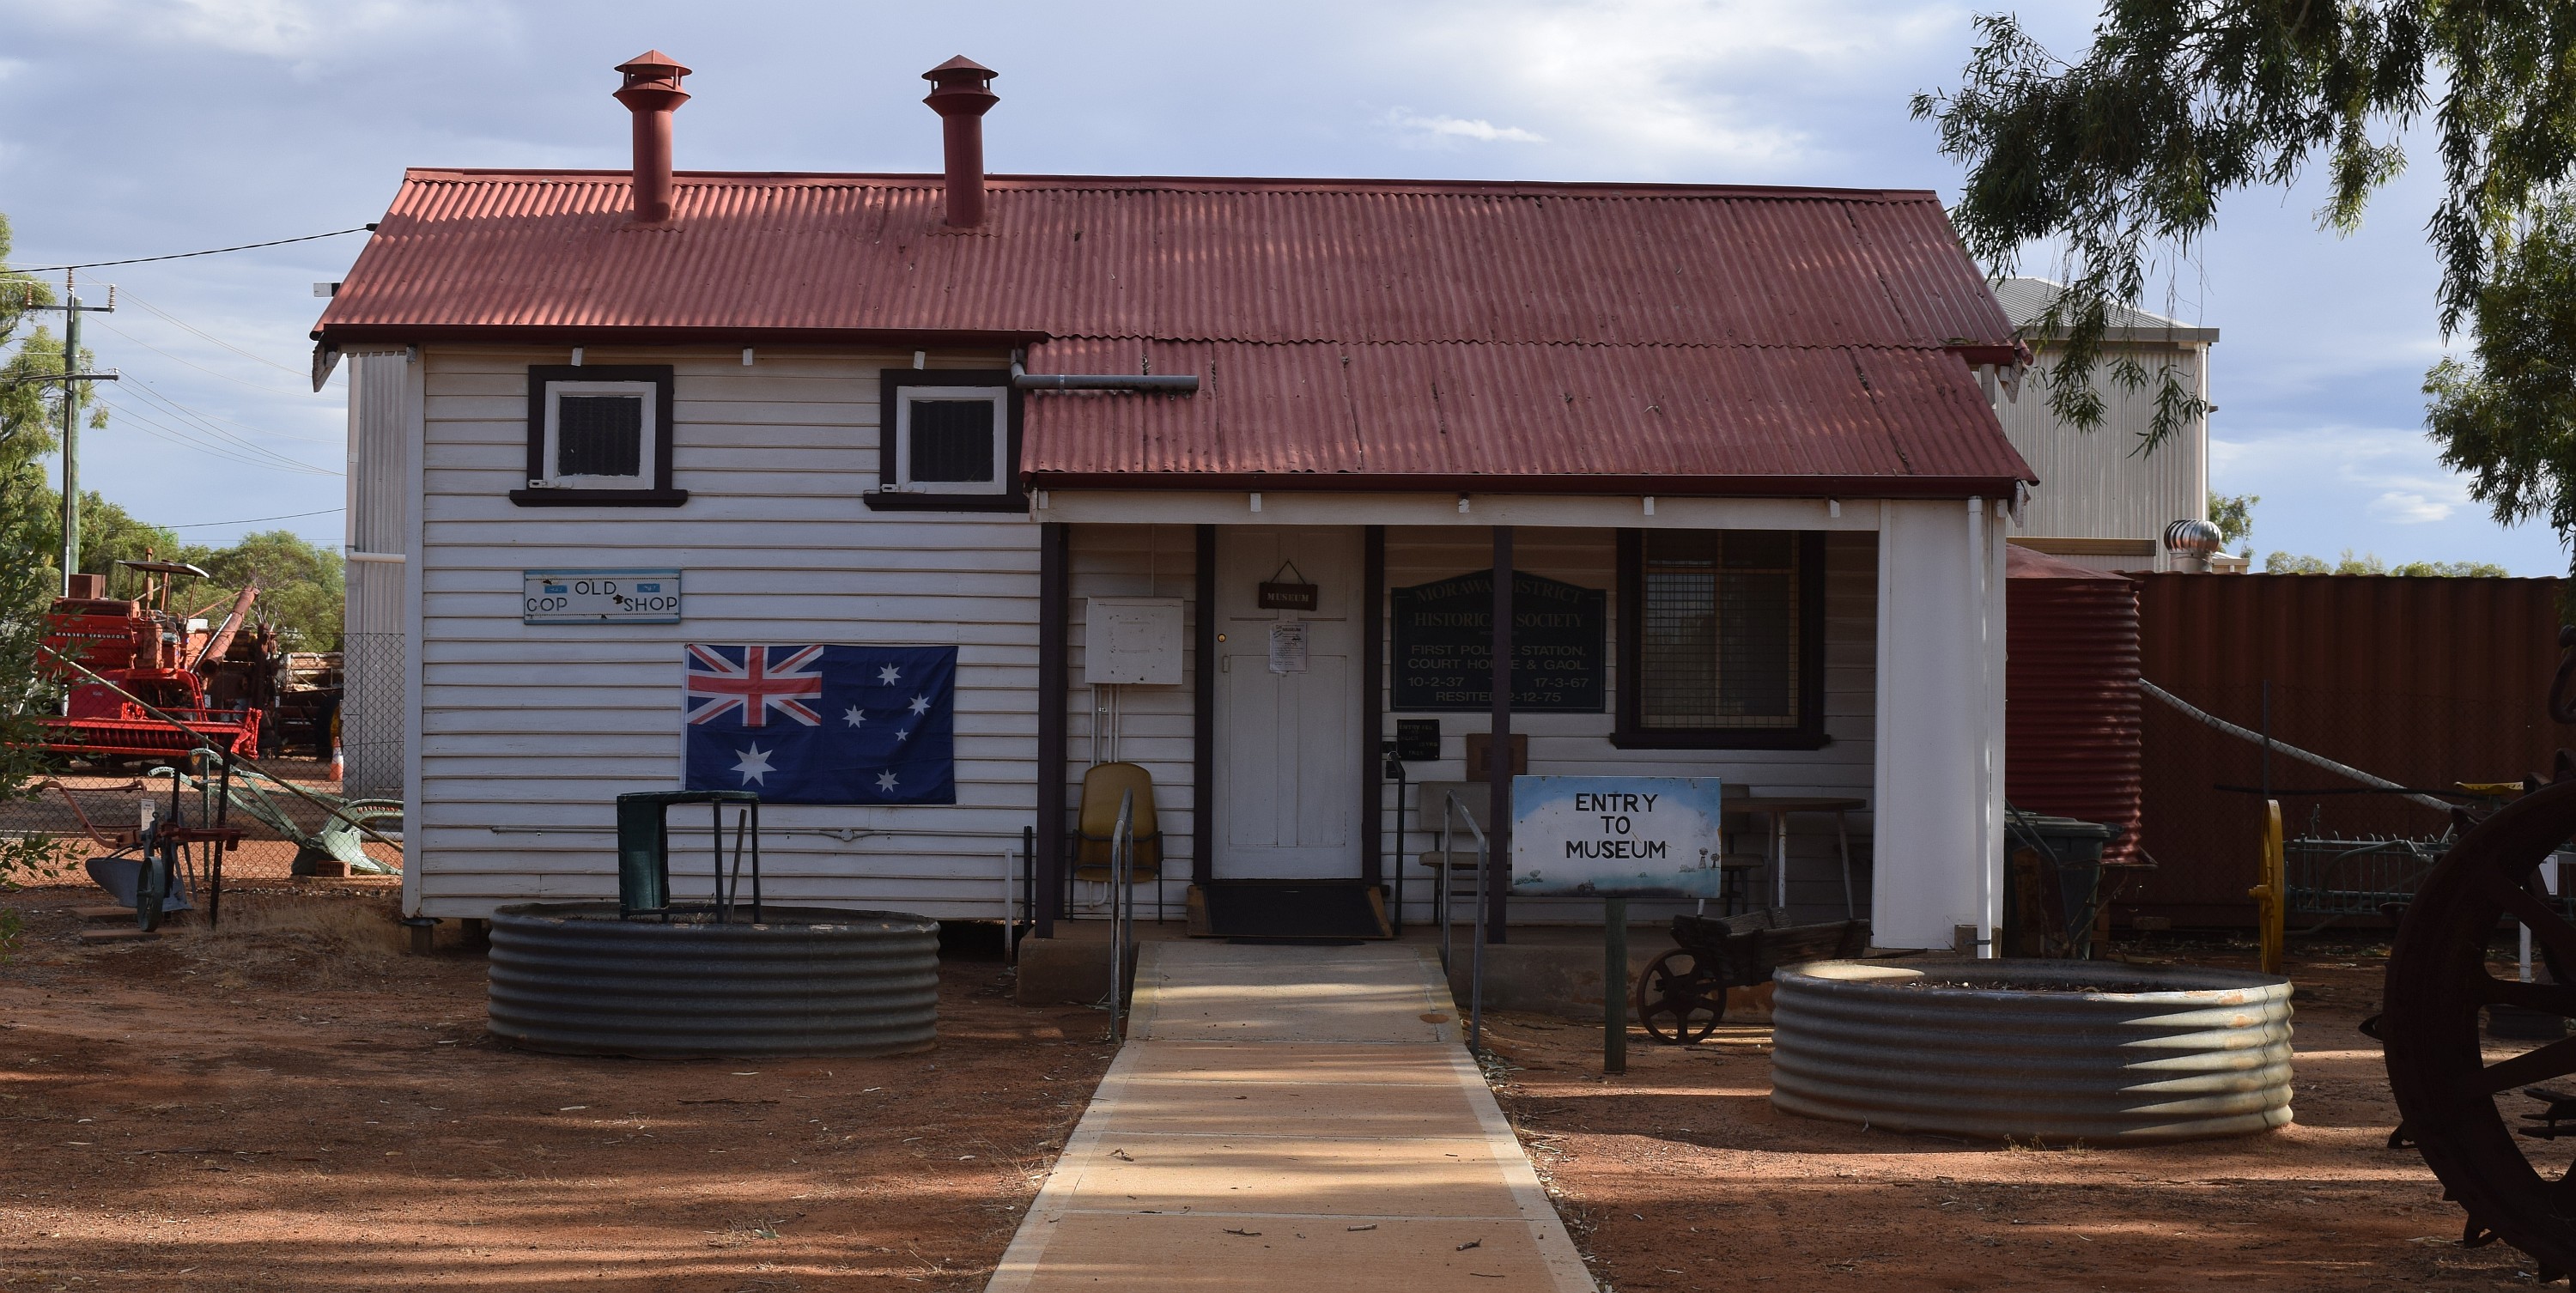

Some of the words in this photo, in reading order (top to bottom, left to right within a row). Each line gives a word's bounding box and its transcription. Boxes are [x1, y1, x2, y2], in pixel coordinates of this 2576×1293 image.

[574, 581, 617, 595] OLD
[1415, 579, 1493, 604] MORAWA
[1511, 580, 1583, 604] ISTRICT
[526, 598, 568, 611] COP
[623, 597, 677, 611] SHOP
[1267, 592, 1309, 602] MUSEUM
[1414, 612, 1493, 627] HISTORIC
[1516, 613, 1583, 628] SOCIETY
[1412, 646, 1455, 655] FIRST
[1461, 646, 1516, 655] POLI
[1408, 659, 1461, 670] COURT
[1467, 659, 1520, 670] HOE
[1527, 659, 1537, 670] &
[1407, 677, 1465, 687] 10-2-37
[1534, 677, 1589, 689] 17-3-67
[1576, 792, 1658, 812] ENTRY
[1601, 816, 1631, 835] TO
[1565, 841, 1666, 859] MUSEUM
